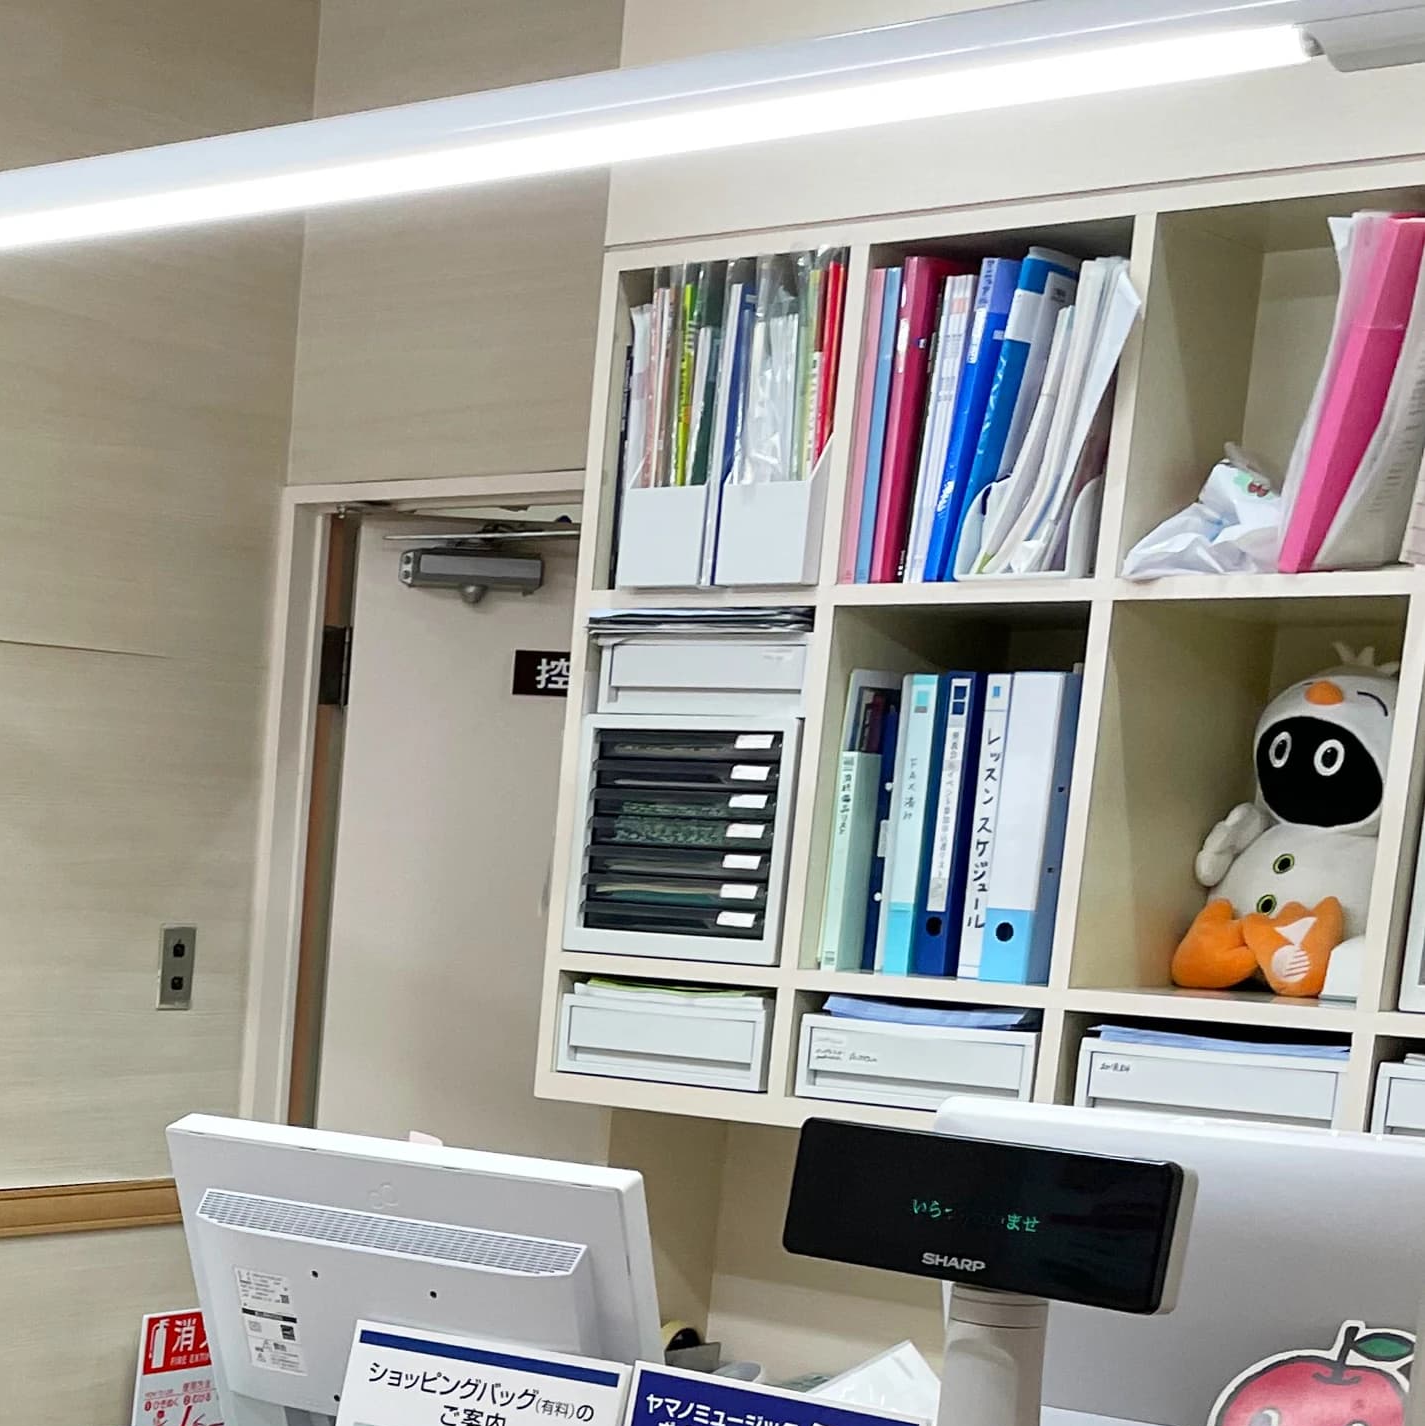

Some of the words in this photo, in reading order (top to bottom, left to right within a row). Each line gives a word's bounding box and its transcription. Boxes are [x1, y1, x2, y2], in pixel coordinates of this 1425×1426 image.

[535, 658, 570, 690] 控
[921, 1252, 986, 1272] SHARP
[368, 1362, 595, 1423] ショッピングバッグ(有料)の
